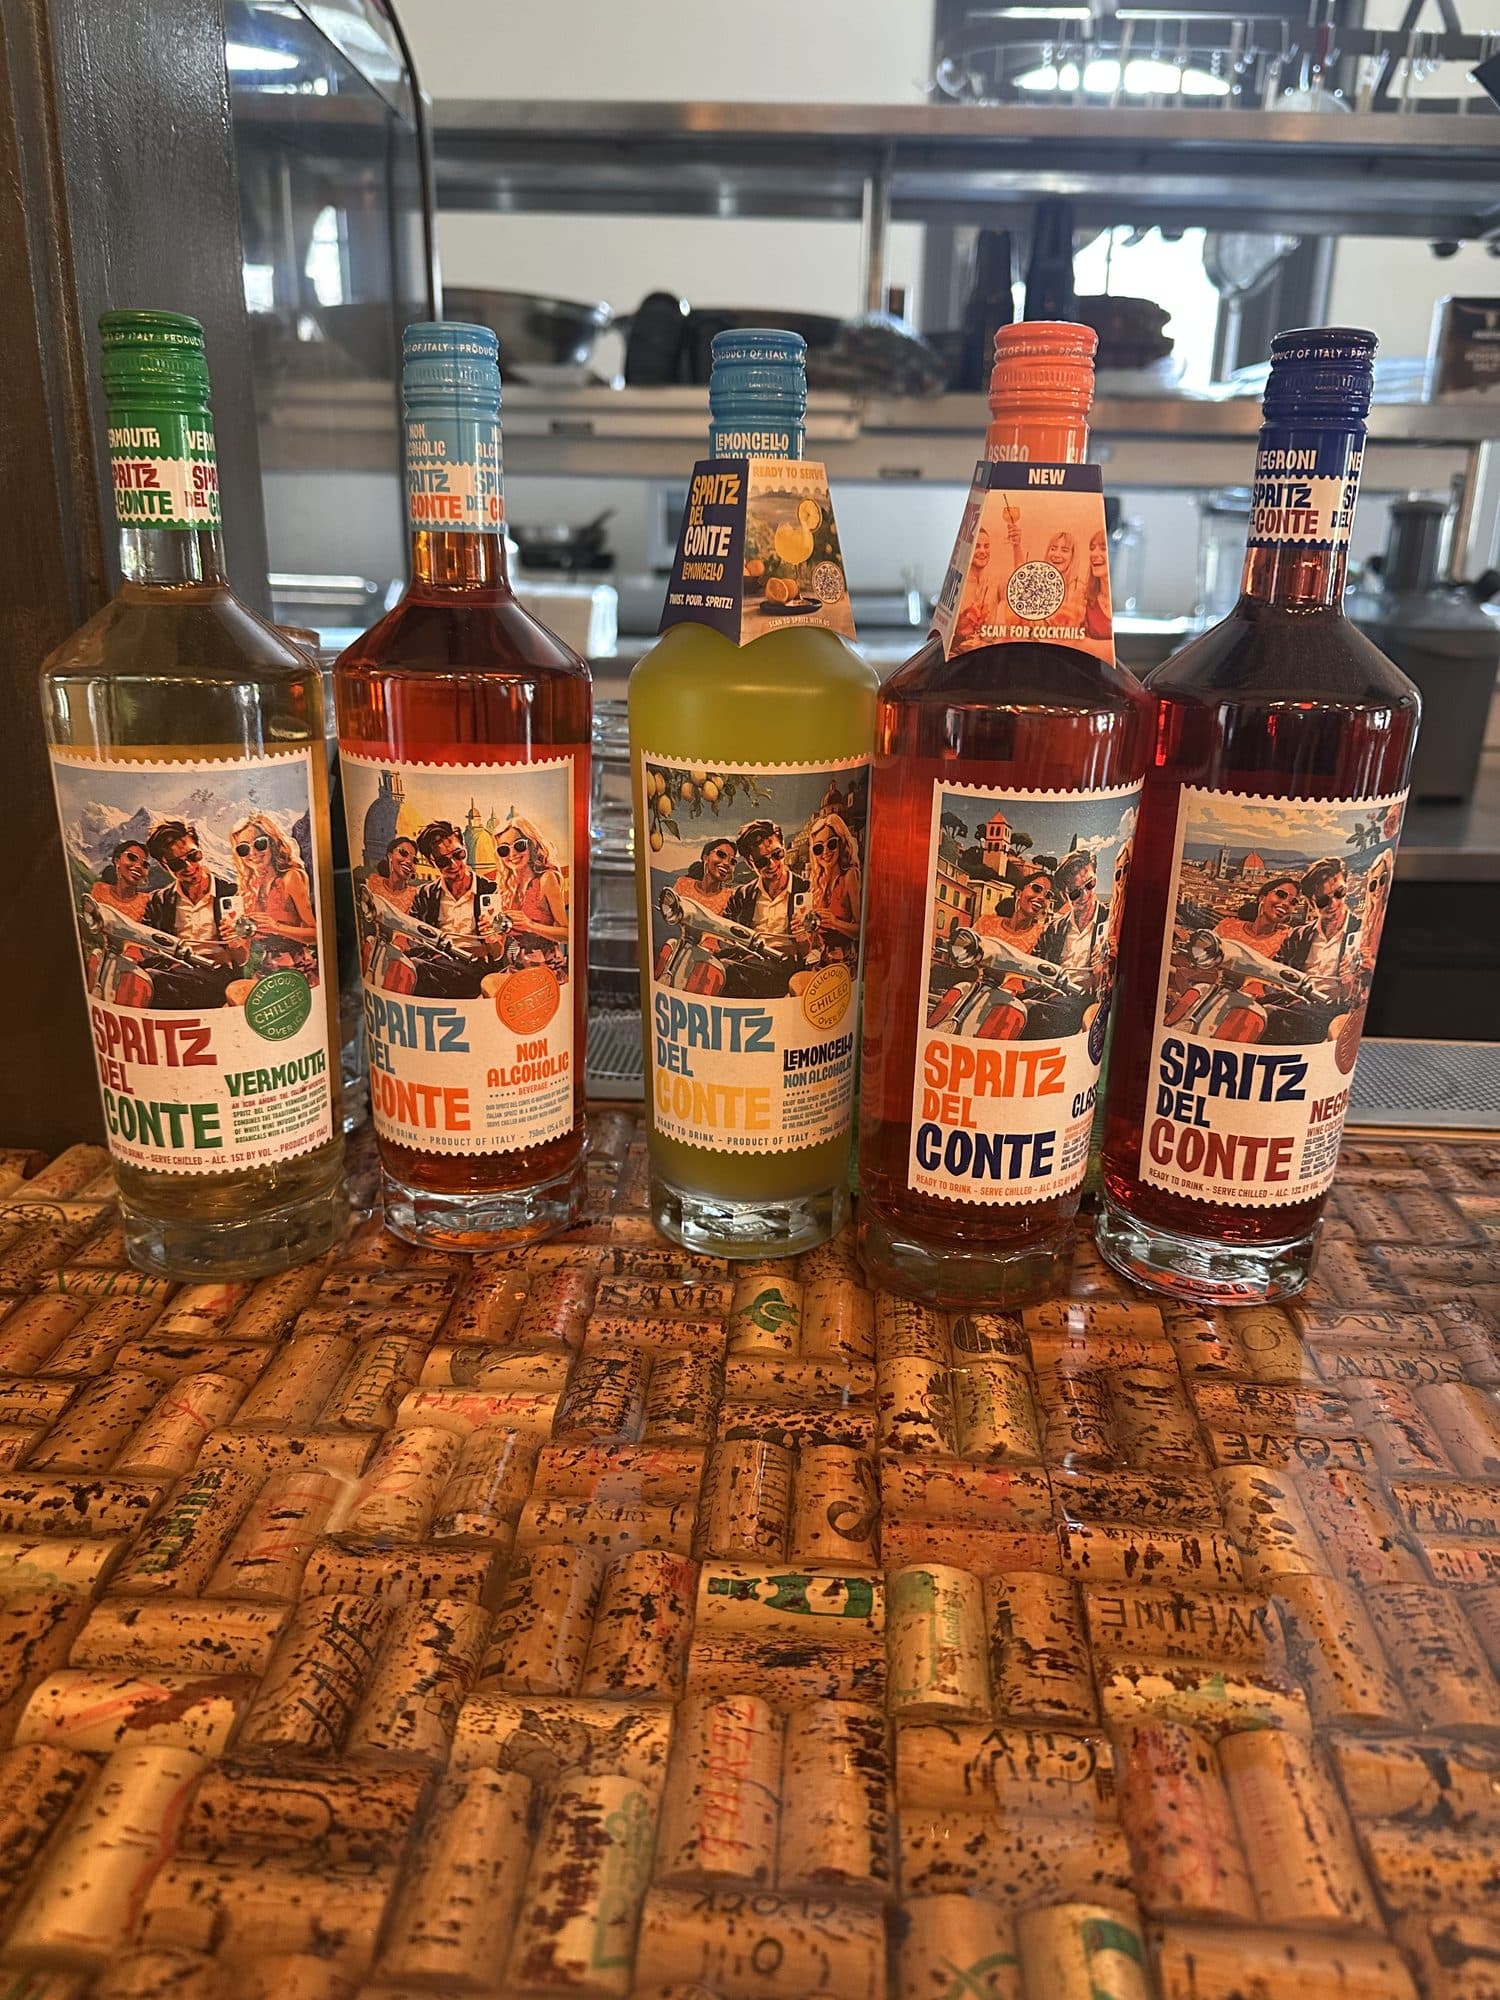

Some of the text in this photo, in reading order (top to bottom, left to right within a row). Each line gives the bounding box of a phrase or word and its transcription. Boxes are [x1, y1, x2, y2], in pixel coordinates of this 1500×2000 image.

[426, 343, 449, 352] ITALY
[765, 350, 787, 359] ITALY
[1296, 348, 1343, 359] OF ITALY
[715, 431, 789, 452] LEMONCELLO
[692, 472, 742, 505] SPRITZ
[752, 466, 825, 481] READY TO SERVE
[1028, 467, 1066, 486] NEW
[116, 489, 174, 515] CONTE
[410, 494, 462, 520] CONTE
[1251, 482, 1312, 508] SPRITZ
[689, 506, 704, 526] DEL
[1255, 508, 1319, 535] CONTE
[684, 525, 733, 558] CONTE
[681, 561, 724, 582] LEMONCELLO
[705, 595, 734, 610] SPRITZ!
[980, 622, 1086, 641] SCAN FOR COCKTAILS
[252, 977, 297, 1005] DELICIOUS
[809, 982, 849, 1014] CHILLED
[91, 1005, 218, 1067] SPRITZ
[267, 1024, 294, 1036] OVER
[364, 989, 470, 1053] SPRITZ
[655, 991, 775, 1053] SPRITZ
[368, 1035, 396, 1075] DEL
[516, 1038, 548, 1063] NON
[657, 1036, 694, 1077] DEL
[783, 1032, 853, 1073] LEMONCELLO
[98, 1055, 135, 1096] DEL
[224, 1048, 327, 1098] VERMOUTH
[487, 1051, 569, 1088] ALCOHOLIC
[783, 1071, 807, 1089] NON
[923, 1040, 1067, 1097] SPRITZ
[1159, 1037, 1309, 1102] SPRITZ
[371, 1065, 471, 1131] CONTE
[655, 1068, 771, 1131] CONTE
[921, 1088, 977, 1129] DEL
[1156, 1084, 1211, 1128] DEL
[103, 1087, 224, 1149] CONTE
[657, 1115, 675, 1131] READY
[677, 1126, 686, 1137] TO
[688, 1129, 714, 1143] DRINK
[727, 1136, 769, 1147] PRODUCT
[772, 1135, 783, 1145] OF
[787, 1131, 809, 1143] ITALY
[1307, 1124, 1325, 1138] WINE
[151, 1153, 172, 1165] SERVE
[212, 1155, 229, 1165] ALC.
[246, 1150, 256, 1160] BY
[258, 1147, 272, 1157] VOL
[280, 1137, 308, 1153] PRODUCT
[396, 1127, 418, 1141] DRINK
[430, 1136, 471, 1146] PRODUCT
[475, 1137, 486, 1146] OF
[491, 1134, 516, 1145] ITALY
[916, 1122, 1057, 1180] CONTE
[1149, 1117, 1295, 1182] CONTE
[916, 1174, 938, 1188] READY
[939, 1180, 948, 1190] TO
[948, 1182, 972, 1195] DRINK
[980, 1186, 1003, 1196] SERVE
[1004, 1186, 1033, 1196] CHILLED
[1149, 1167, 1170, 1183] READY
[1171, 1176, 1180, 1186] TO
[1181, 1178, 1204, 1192] DRINK
[1212, 1186, 1236, 1197] SERVE
[1238, 1188, 1268, 1199] CHILLED
[1275, 1188, 1289, 1198] ALC.
[601, 1284, 723, 1310] SAVE
[1336, 1354, 1463, 1383] SCREW
[1222, 1431, 1367, 1469] LOVE
[755, 1446, 788, 1553] SCREW
[1103, 1527, 1189, 1544] WINERY
[691, 1890, 838, 1920] CLOCK
